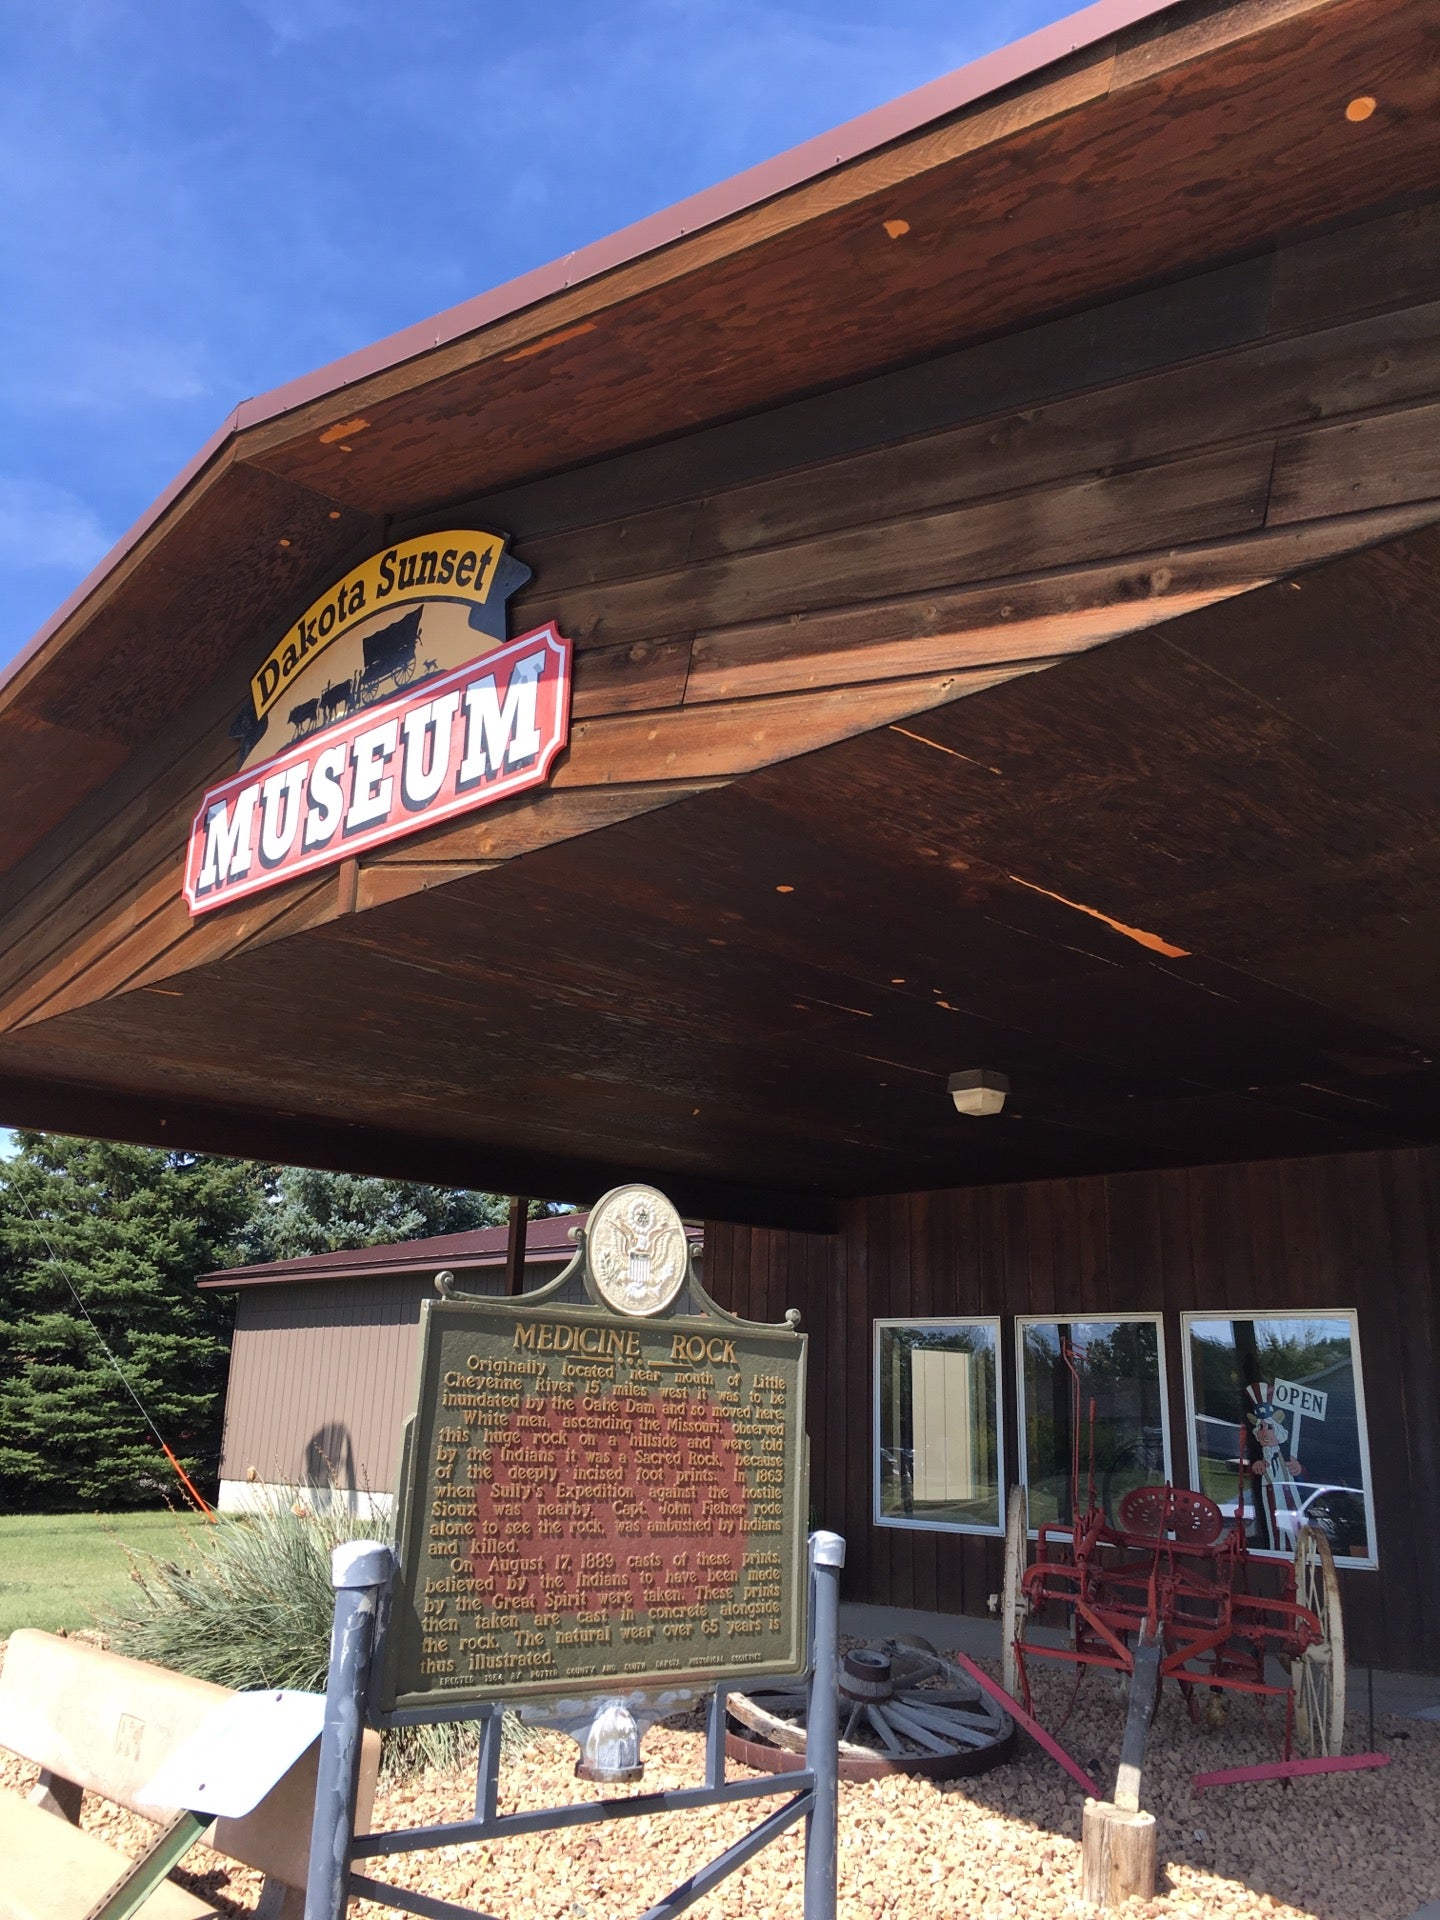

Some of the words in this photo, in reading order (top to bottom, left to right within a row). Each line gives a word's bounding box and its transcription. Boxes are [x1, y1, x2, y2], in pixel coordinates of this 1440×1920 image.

[257, 582, 366, 700] Dakota
[376, 545, 494, 600] Sunset
[196, 649, 547, 898] MUSEUM
[513, 1322, 640, 1356] MEDICINE
[670, 1335, 738, 1363] ROCK
[467, 1355, 547, 1376] Originally
[562, 1362, 614, 1378] located
[631, 1370, 661, 1381] near
[675, 1372, 713, 1385] mouth
[728, 1374, 741, 1386] of
[753, 1375, 786, 1389] Little
[444, 1372, 522, 1390] Cheyenne
[536, 1377, 574, 1392] River
[586, 1380, 600, 1394] 15
[613, 1384, 647, 1397] miles
[660, 1387, 688, 1399] west
[698, 1388, 707, 1400] it
[718, 1392, 739, 1401] was
[750, 1392, 761, 1403] to
[770, 1392, 784, 1404] be
[1276, 1385, 1324, 1414] OPEN
[442, 1390, 519, 1408] inundated
[526, 1395, 544, 1411] by
[552, 1395, 574, 1410] the
[583, 1397, 618, 1412] Oahe
[626, 1399, 655, 1414] Dam
[663, 1403, 685, 1415] and
[691, 1405, 705, 1416] so
[713, 1404, 750, 1417] moved
[756, 1406, 785, 1420] here.
[464, 1410, 508, 1426] White
[563, 1415, 632, 1431] ascending
[640, 1419, 660, 1430] the
[732, 1423, 784, 1435] observed
[439, 1426, 469, 1442] this
[484, 1429, 520, 1445] huge
[533, 1430, 567, 1444] rock
[579, 1434, 596, 1445] on
[609, 1436, 617, 1446] a
[630, 1435, 677, 1448] hillside
[688, 1437, 710, 1449] and
[722, 1439, 751, 1450] were
[761, 1439, 782, 1450] told
[437, 1445, 457, 1462] by
[467, 1447, 492, 1461] the
[501, 1448, 554, 1462] Indians
[565, 1448, 576, 1462] it
[586, 1451, 611, 1463] was
[619, 1453, 627, 1463] a
[634, 1450, 680, 1464] Sacred
[736, 1454, 783, 1466] because
[435, 1464, 452, 1478] of
[467, 1465, 492, 1478] the
[509, 1466, 557, 1481] deeply
[574, 1466, 623, 1480] incised
[636, 1468, 664, 1481] foot
[734, 1468, 746, 1482] In
[756, 1469, 783, 1482] 1863
[434, 1483, 476, 1497] when
[490, 1483, 543, 1500] Sully's
[557, 1483, 634, 1499] Expedition
[650, 1484, 696, 1500] against
[708, 1485, 729, 1498] the
[742, 1485, 781, 1498] hostile
[432, 1502, 477, 1517] Sioux
[493, 1503, 520, 1515] was
[612, 1501, 647, 1517] Capt.
[659, 1502, 691, 1514] John
[754, 1502, 782, 1514] rode
[430, 1521, 474, 1536] alone
[483, 1521, 498, 1533] to
[505, 1522, 531, 1533] see
[538, 1520, 562, 1533] the
[615, 1521, 640, 1532] was
[647, 1519, 711, 1532] ambushed
[719, 1518, 734, 1533] by
[739, 1518, 781, 1531] Indians
[428, 1540, 458, 1554] and
[471, 1538, 519, 1554] killed.
[451, 1558, 473, 1573] On
[489, 1556, 544, 1575] August
[581, 1553, 614, 1568] 1889
[628, 1553, 661, 1566] casts
[673, 1552, 686, 1566] of
[697, 1552, 731, 1565] these
[425, 1577, 494, 1593] believed
[507, 1575, 526, 1591] by
[540, 1574, 563, 1588] the
[577, 1572, 628, 1585] Indians
[640, 1571, 653, 1584] to
[666, 1569, 697, 1583] have
[708, 1569, 738, 1581] been
[748, 1568, 780, 1581] made
[424, 1597, 445, 1614] by
[456, 1596, 481, 1610] the
[492, 1594, 535, 1609] Great
[545, 1590, 586, 1609] Spirit
[598, 1590, 632, 1603] were
[644, 1587, 684, 1601] taken.
[695, 1586, 733, 1599] These
[744, 1583, 780, 1599] prints
[423, 1617, 458, 1631] then
[475, 1613, 519, 1629] taken
[534, 1613, 560, 1625] are
[577, 1609, 607, 1622] cast
[621, 1606, 634, 1620] in
[650, 1604, 707, 1619] concrete
[720, 1599, 779, 1616] alongside
[423, 1637, 448, 1652] the
[514, 1631, 544, 1646] The
[556, 1626, 610, 1643] natural
[620, 1626, 654, 1639] wear
[663, 1624, 693, 1636] over
[701, 1619, 718, 1633] 65
[727, 1619, 761, 1634] years
[768, 1616, 780, 1630] is
[420, 1657, 455, 1673] thus
[469, 1650, 556, 1670] illustrated.
[567, 1665, 596, 1675] COUNTY
